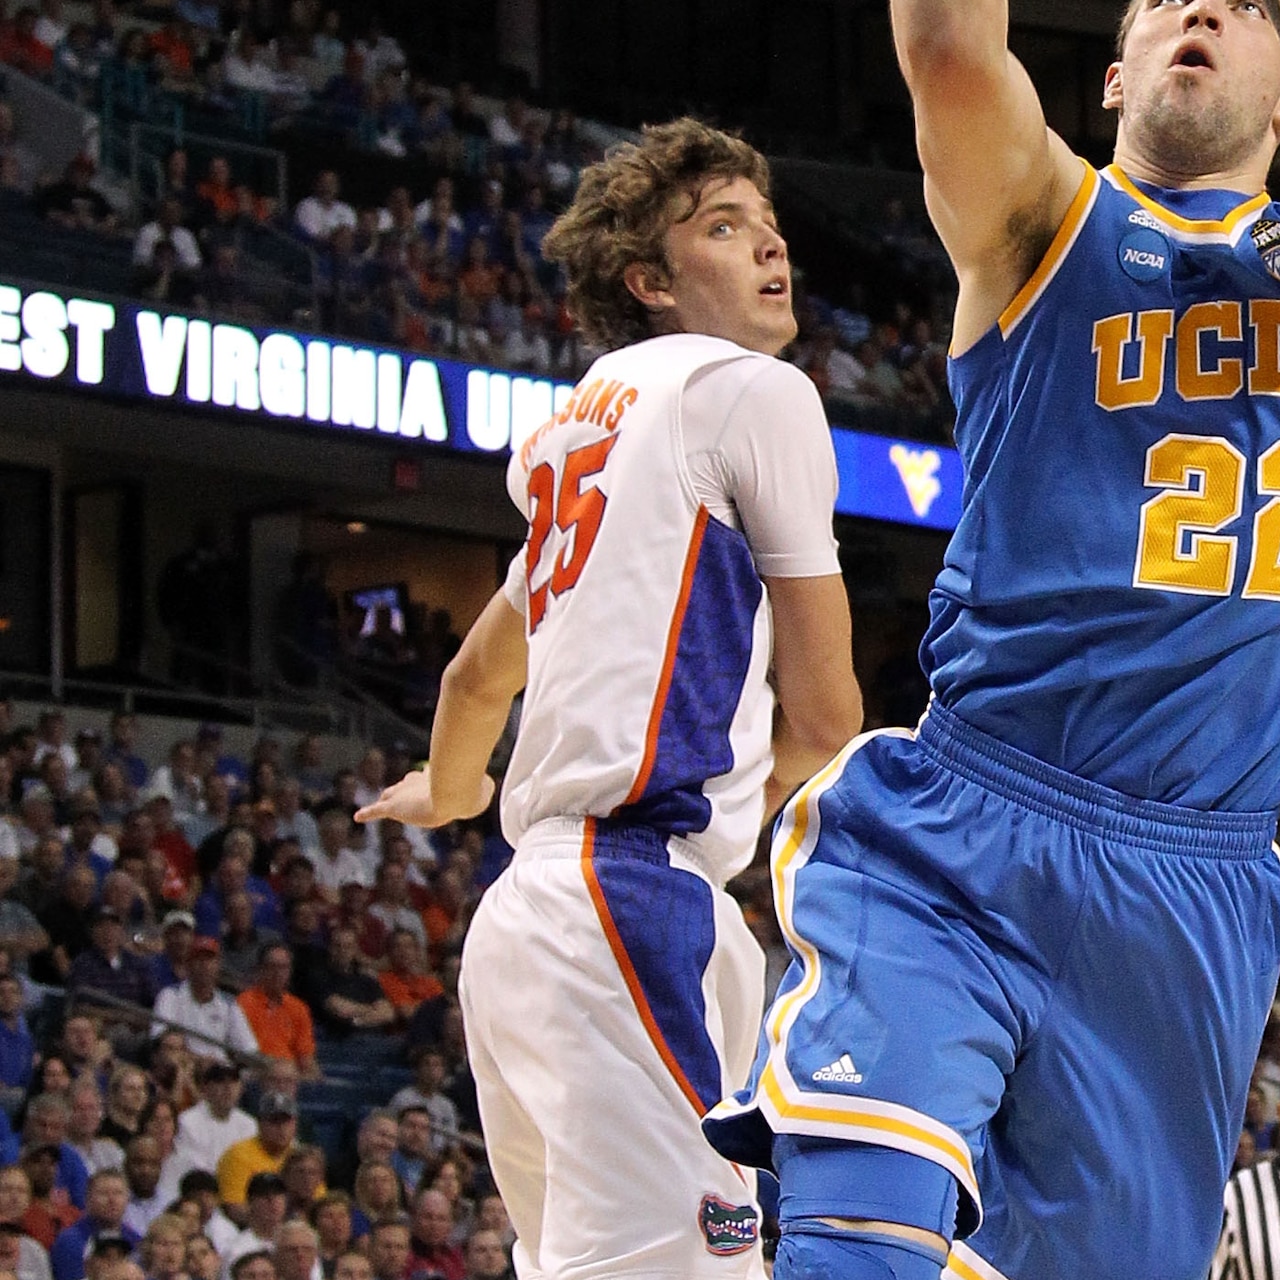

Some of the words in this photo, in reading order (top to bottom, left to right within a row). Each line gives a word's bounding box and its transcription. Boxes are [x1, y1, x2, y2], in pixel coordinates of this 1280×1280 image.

[1123, 248, 1165, 270] NCAA
[136, 310, 449, 442] VIRGINIA
[526, 430, 622, 636] 25
[812, 1071, 863, 1084] adidas
